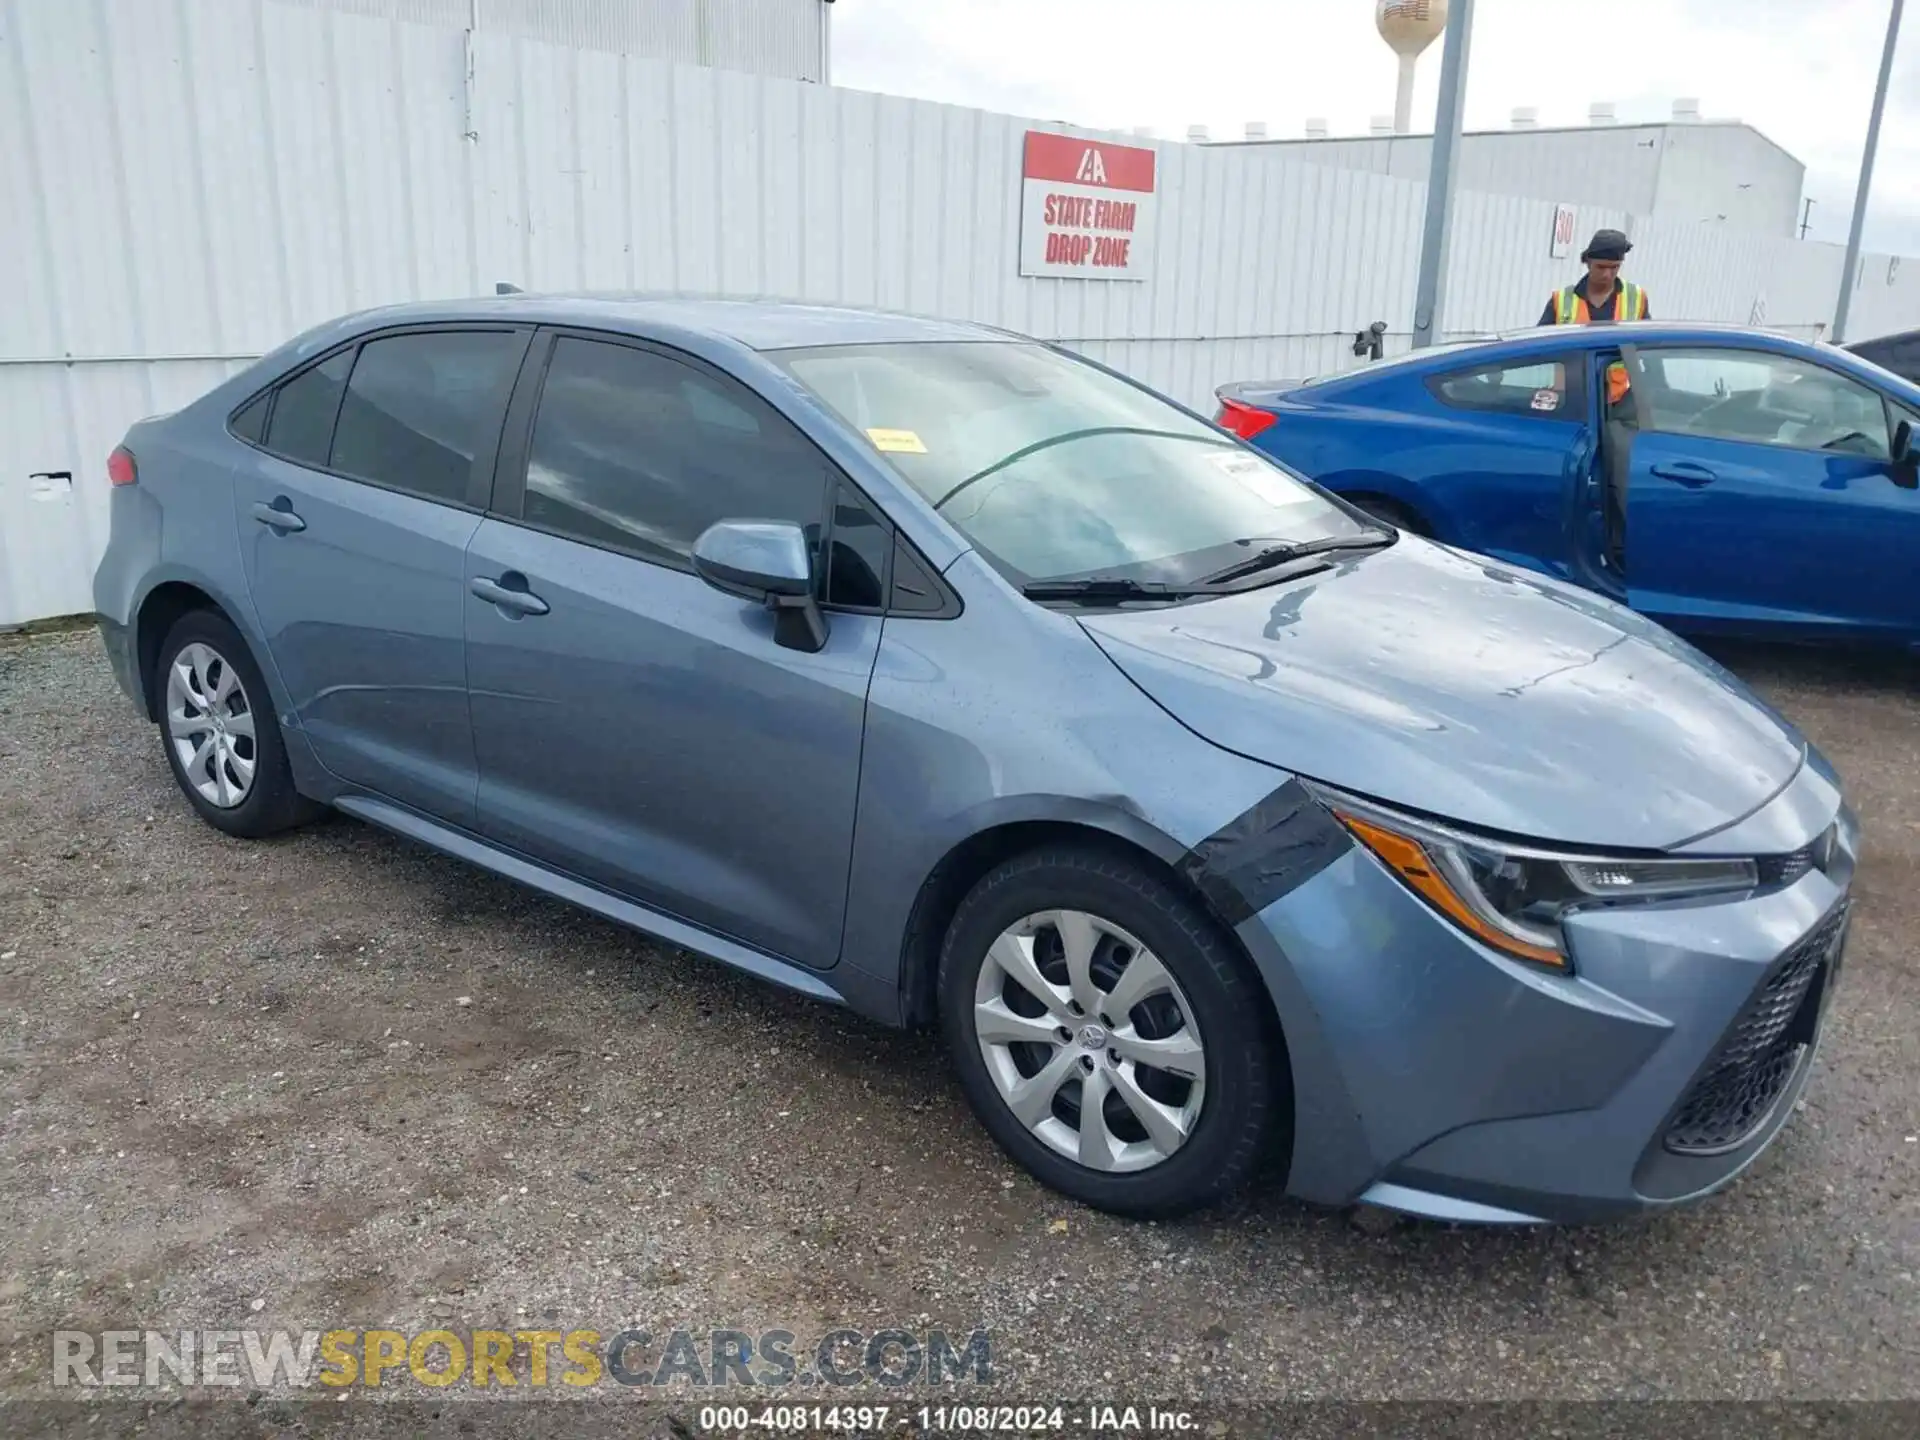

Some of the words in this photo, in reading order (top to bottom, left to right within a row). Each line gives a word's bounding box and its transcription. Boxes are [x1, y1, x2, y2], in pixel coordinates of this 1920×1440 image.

[1044, 194, 1093, 229] STATE
[1094, 199, 1137, 232] FARM
[1045, 232, 1091, 266] DROP
[1091, 236, 1131, 268] ZONE
